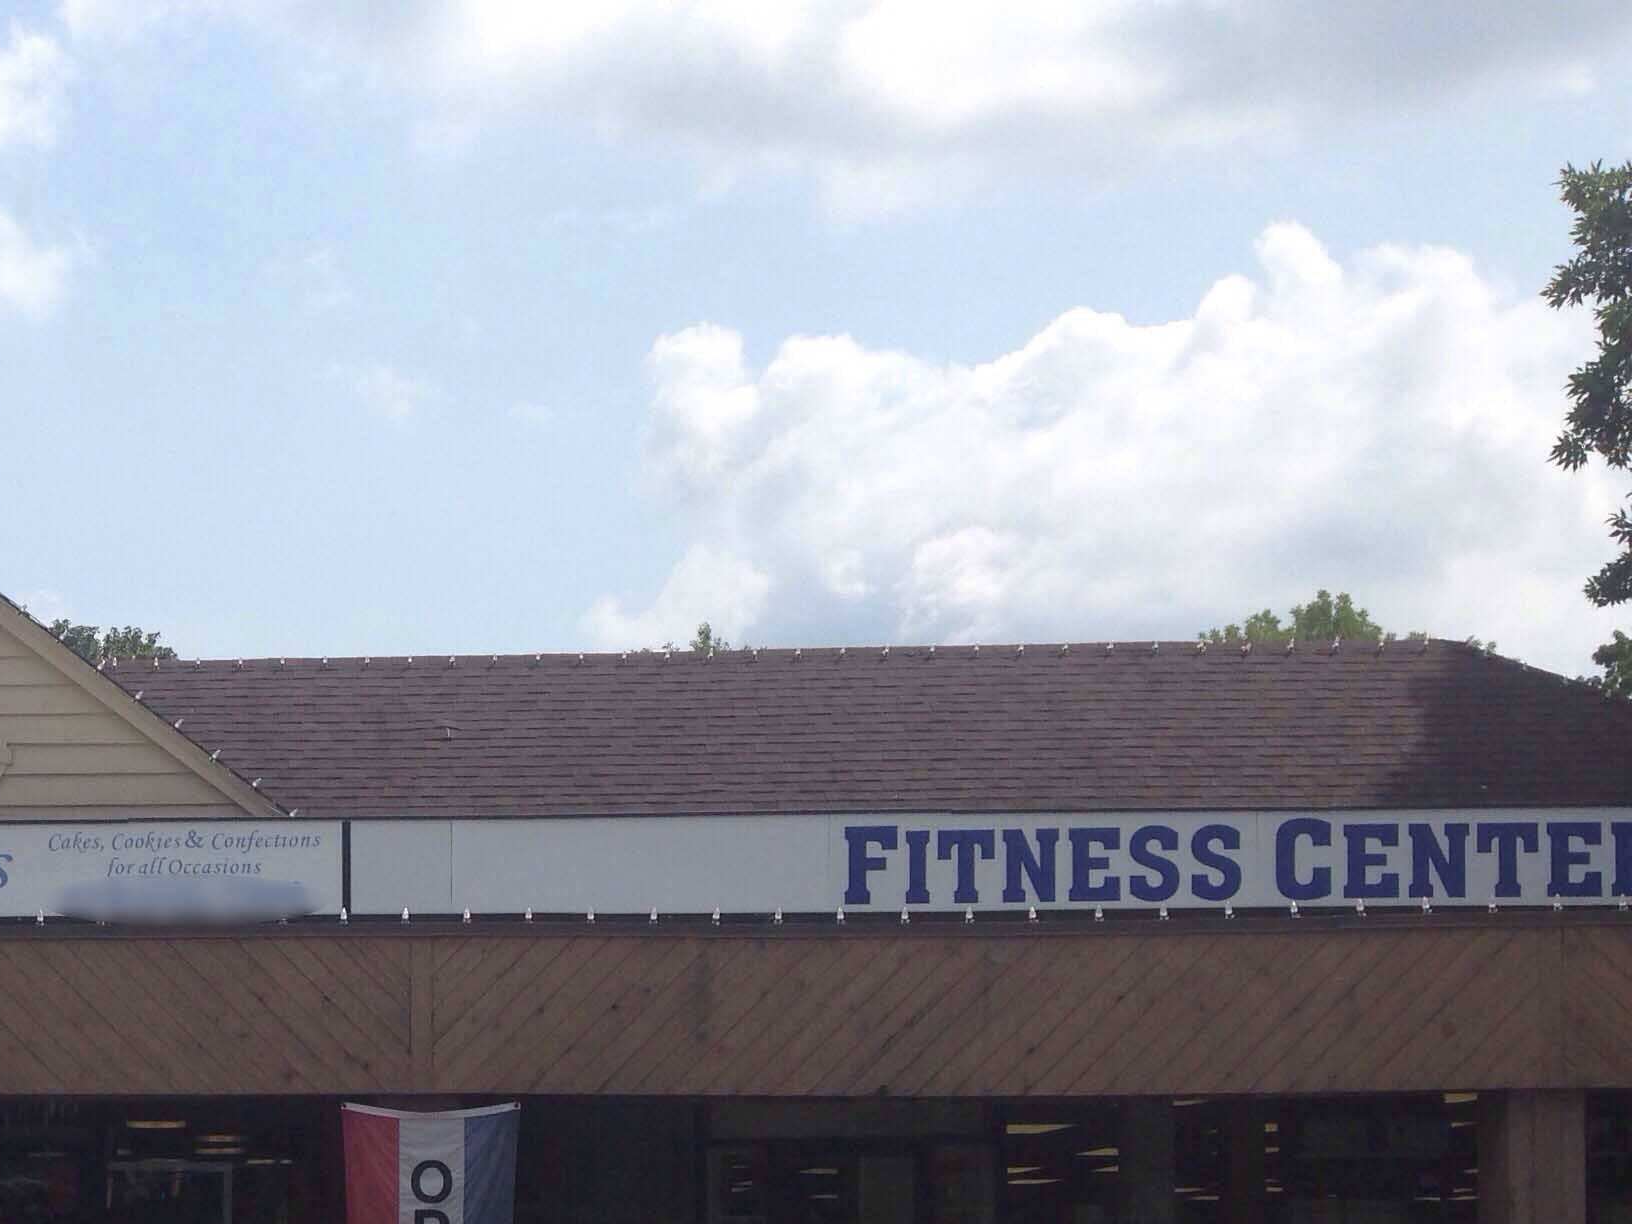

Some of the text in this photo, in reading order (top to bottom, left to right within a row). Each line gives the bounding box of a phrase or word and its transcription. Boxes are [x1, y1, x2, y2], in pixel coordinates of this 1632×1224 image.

[48, 830, 321, 853] Cakes, Cookies & Confections
[106, 857, 262, 878] for all Occasions
[844, 825, 1242, 905] FITNESS
